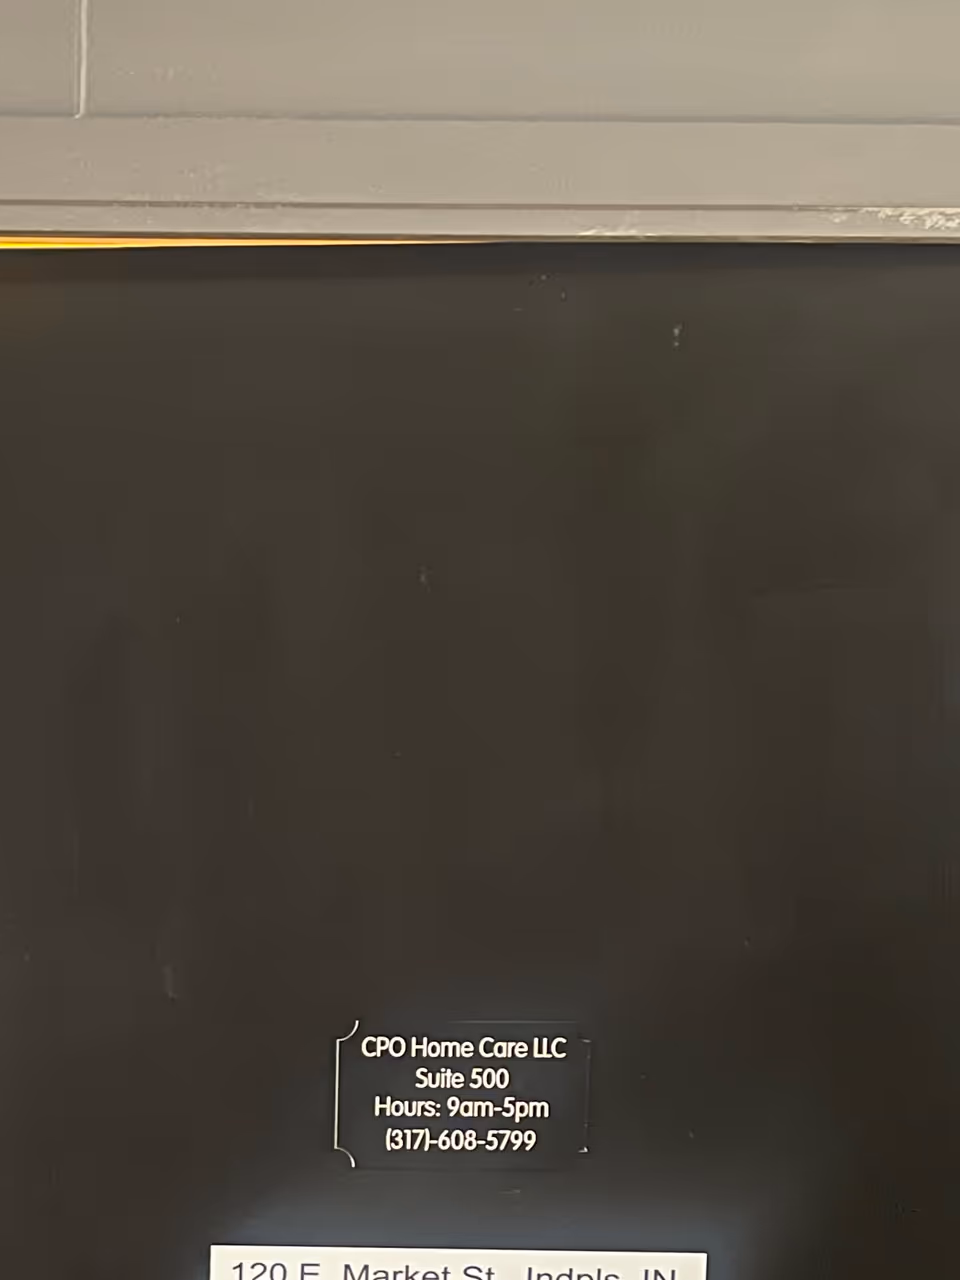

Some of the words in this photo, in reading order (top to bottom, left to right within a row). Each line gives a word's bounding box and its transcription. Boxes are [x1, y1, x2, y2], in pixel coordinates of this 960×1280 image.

[362, 1037, 406, 1057] CPO
[411, 1037, 474, 1057] Home
[479, 1037, 528, 1058] Care
[533, 1038, 566, 1058] LLC
[415, 1068, 464, 1088] Suite
[469, 1068, 509, 1088] 500
[375, 1096, 441, 1116] Hours:
[447, 1097, 548, 1121] 9am-5pm
[386, 1128, 536, 1151] (317)-608-5799
